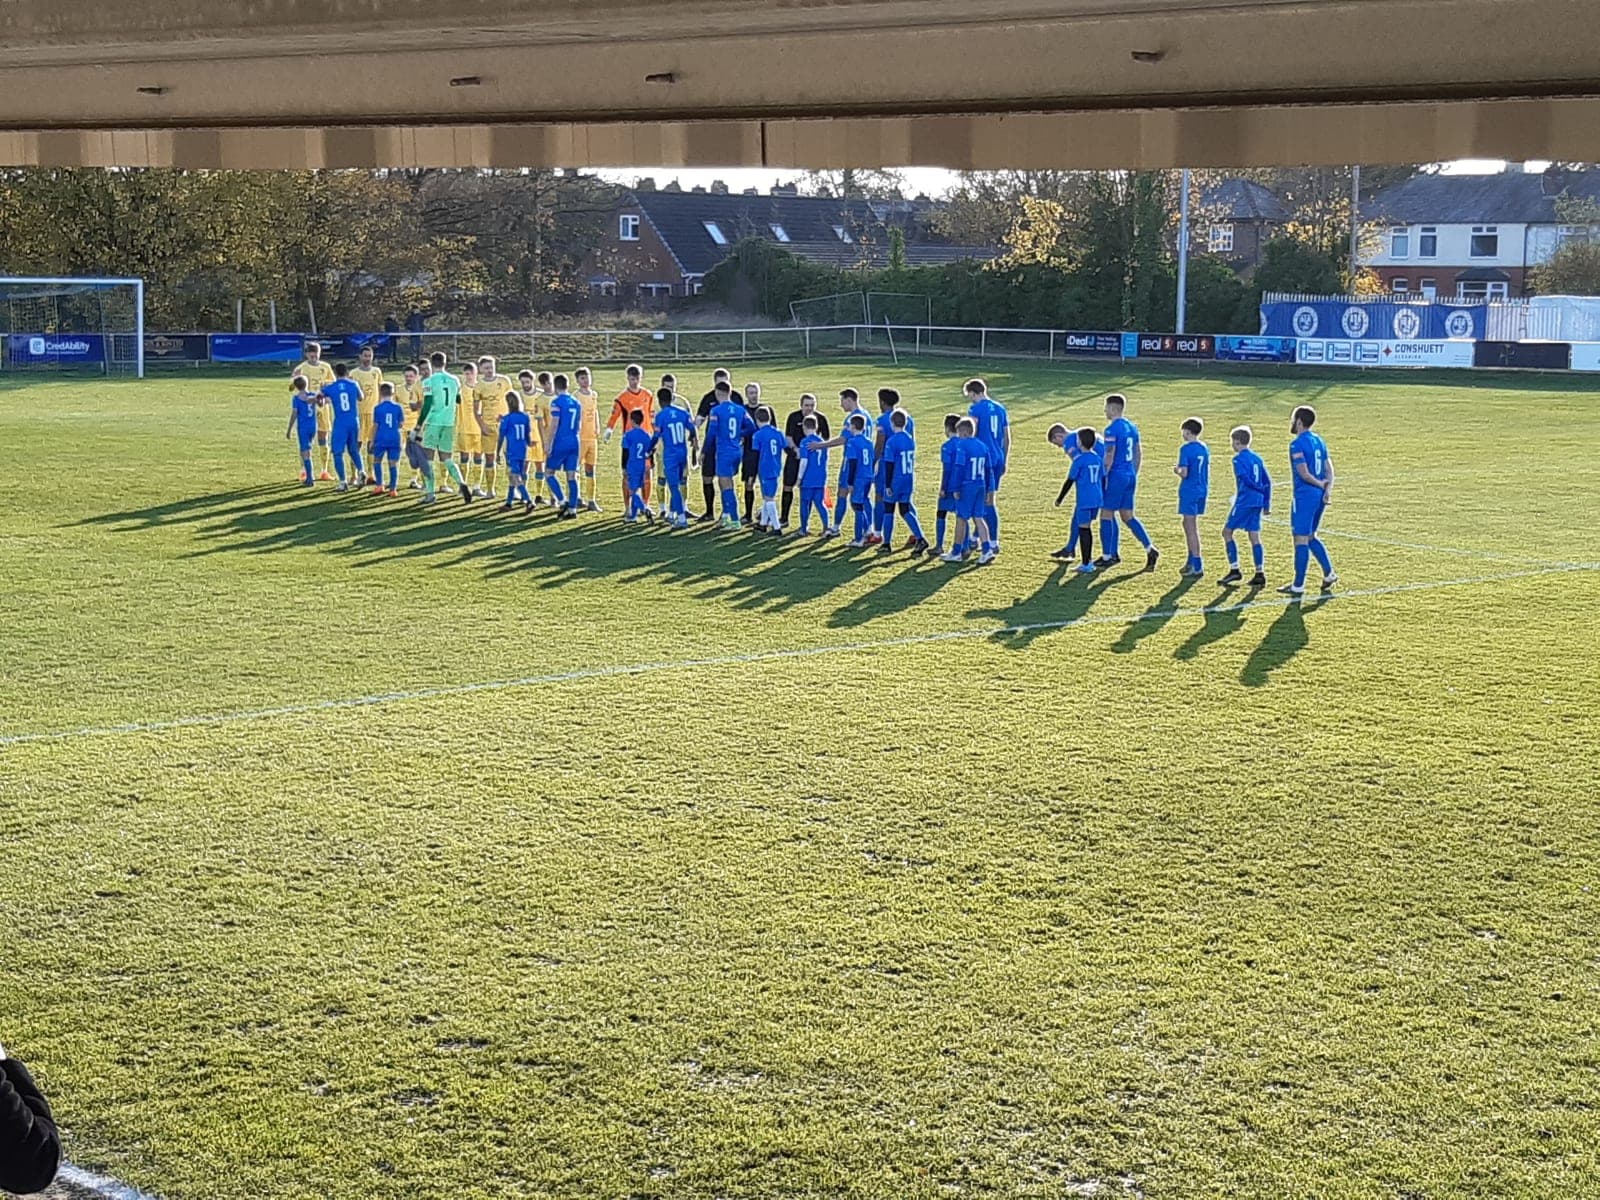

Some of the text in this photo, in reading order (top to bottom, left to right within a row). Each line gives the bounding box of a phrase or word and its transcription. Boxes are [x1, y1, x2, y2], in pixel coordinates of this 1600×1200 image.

[46, 341, 90, 353] CredAbility
[1141, 338, 1161, 350] real
[1176, 339, 1197, 351] real
[1394, 343, 1444, 353] CONSHUETT
[340, 392, 350, 412] 8
[442, 387, 449, 407] 1
[307, 403, 313, 417] 5
[568, 408, 577, 430] 7
[385, 413, 393, 428] 4
[728, 417, 737, 439] 9
[514, 424, 525, 440] 11
[667, 421, 685, 445] 10
[636, 442, 643, 459] 2
[770, 439, 778, 456] 6
[1125, 437, 1133, 462] 3
[862, 448, 870, 466] 8
[900, 450, 913, 475] 15
[1197, 455, 1204, 474] 7
[1314, 449, 1322, 475] 6
[970, 456, 986, 481] 14
[1088, 465, 1100, 483] 17
[1253, 463, 1260, 483] 9
